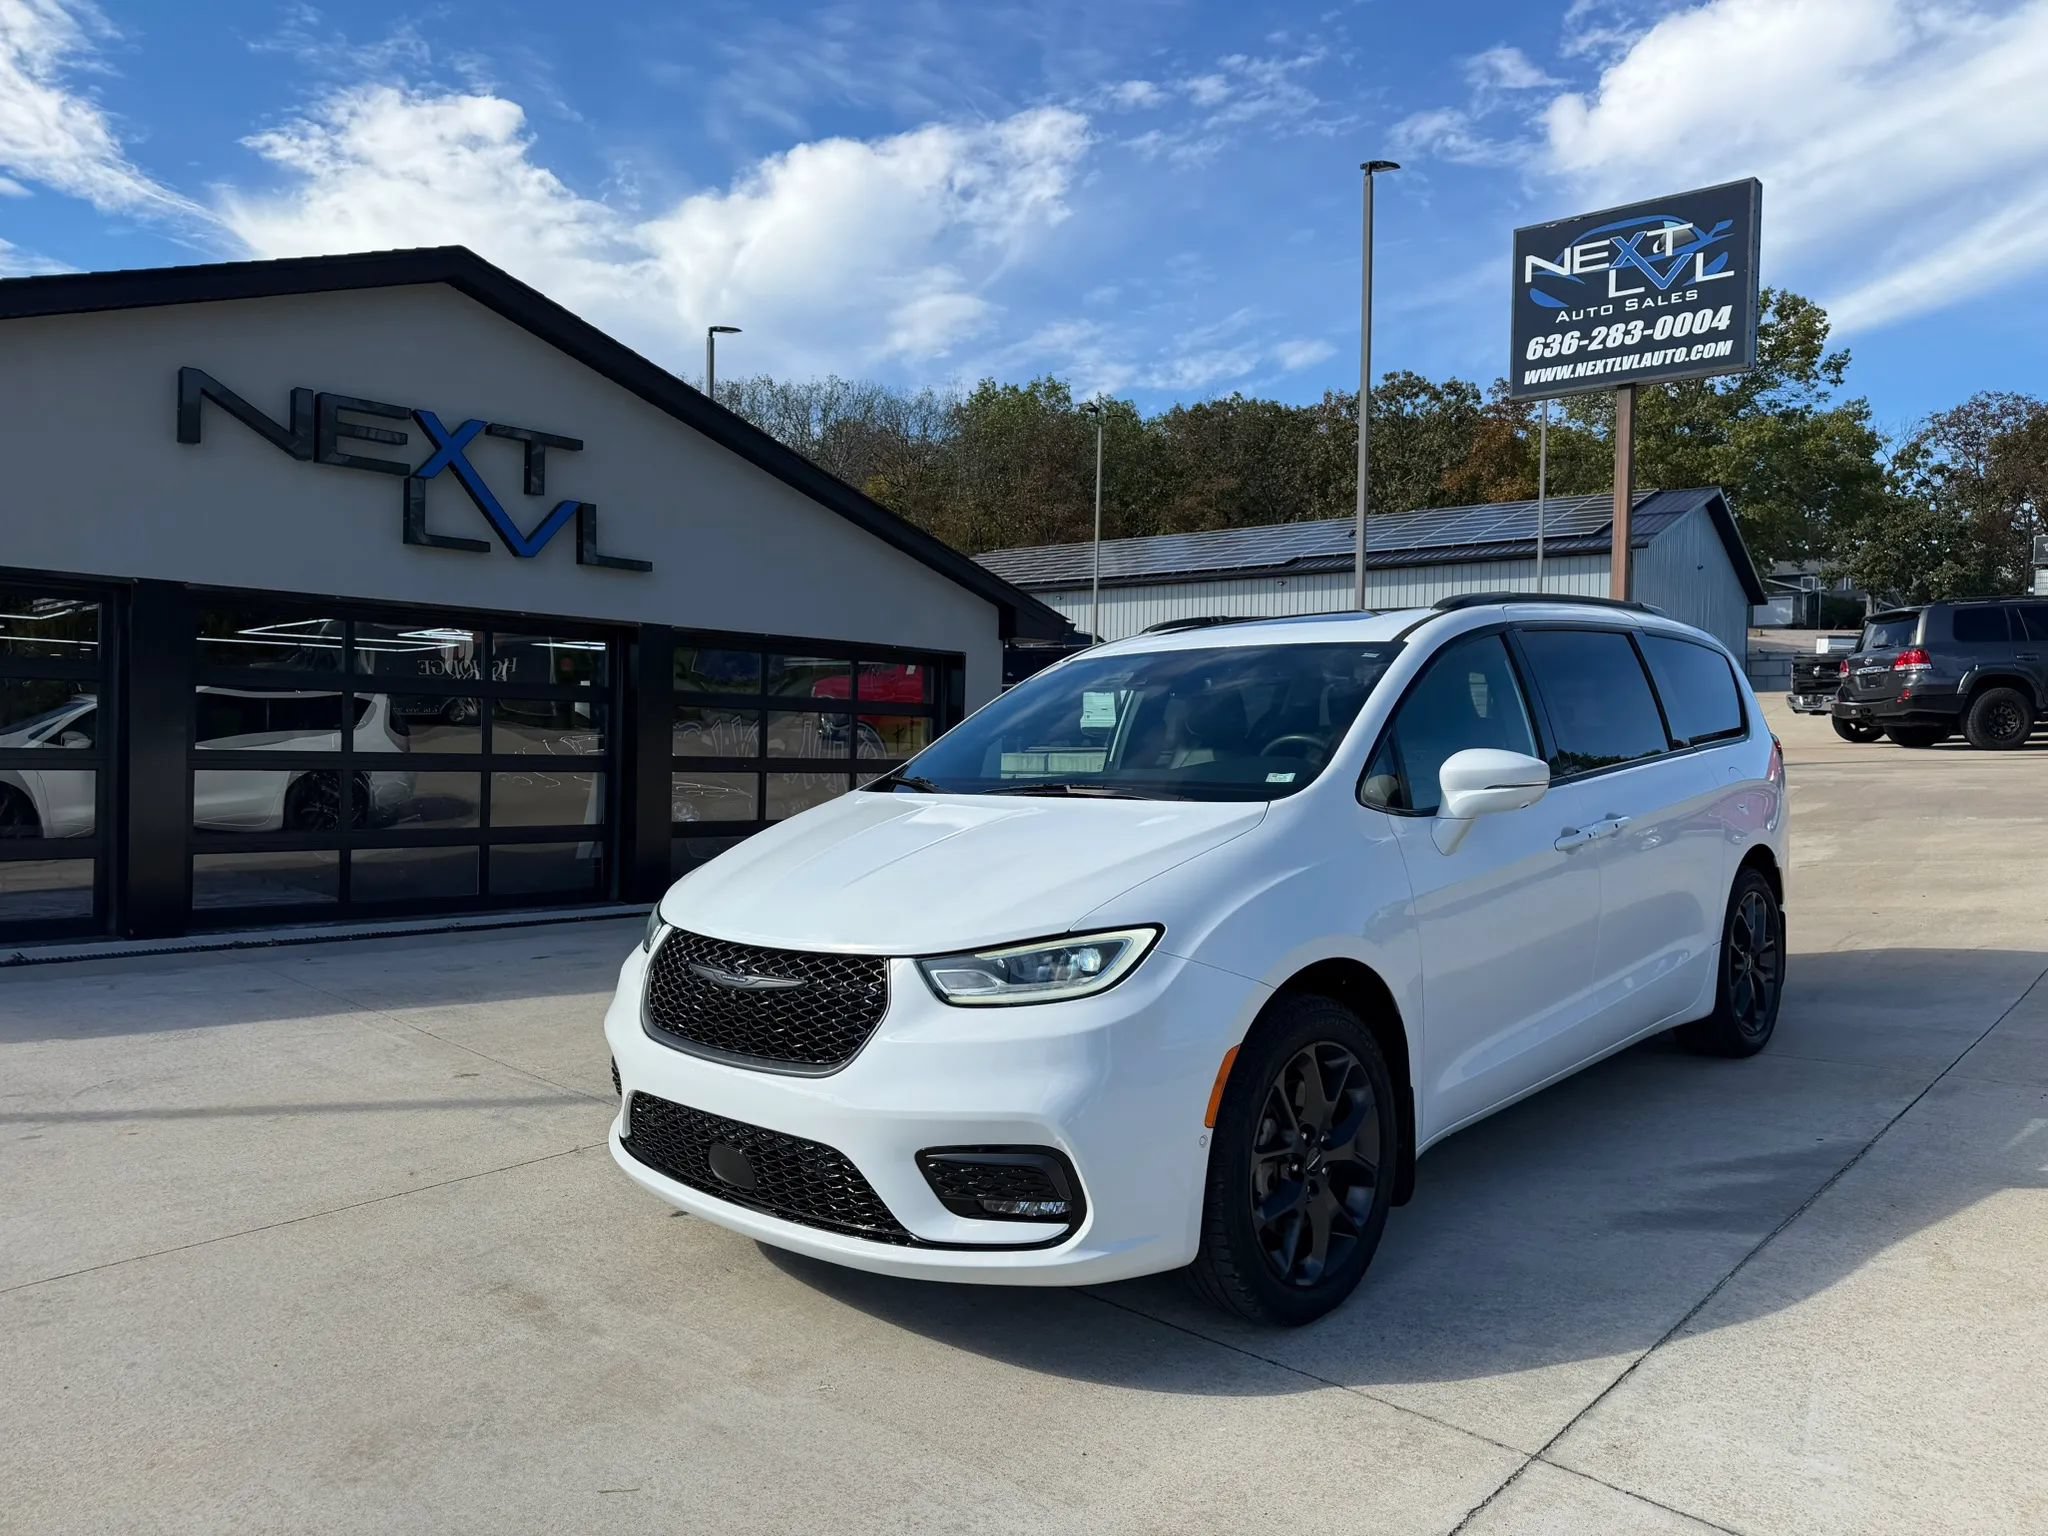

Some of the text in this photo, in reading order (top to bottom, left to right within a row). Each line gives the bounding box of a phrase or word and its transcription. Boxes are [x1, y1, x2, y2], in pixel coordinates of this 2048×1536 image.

[1524, 222, 1694, 284] NEXT
[1608, 252, 1735, 298] LVL
[1525, 304, 1733, 361] 636-283-0004
[1555, 289, 1698, 324] AUTO SALES
[1523, 339, 1734, 385] WWW.NEXTLVLAUTO.COM
[176, 366, 584, 497] NEXT
[403, 474, 653, 572] LVL
